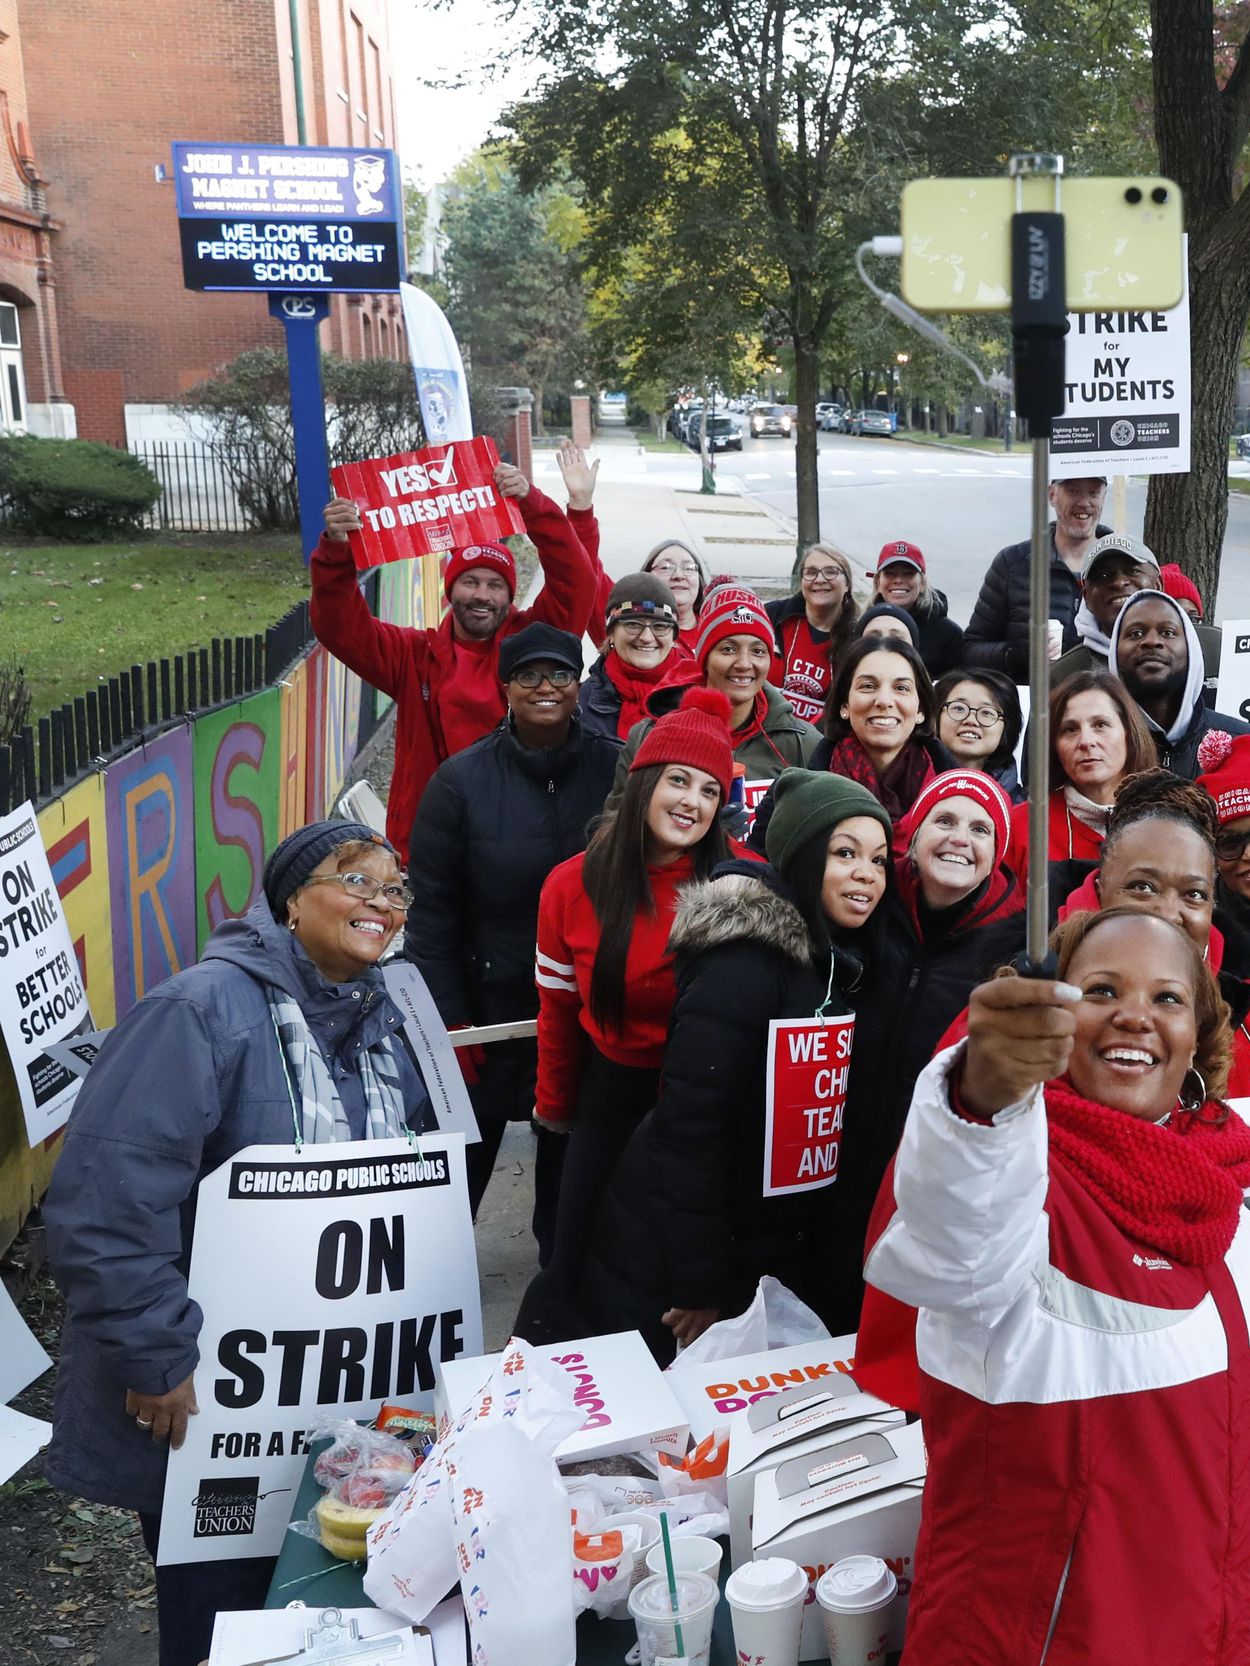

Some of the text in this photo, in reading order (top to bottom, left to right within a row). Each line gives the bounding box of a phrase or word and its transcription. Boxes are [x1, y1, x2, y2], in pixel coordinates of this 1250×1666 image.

[182, 154, 232, 174] JOHN
[258, 155, 349, 178] PERSHING
[191, 178, 343, 201] MAGNET SCHOOL
[221, 224, 353, 243] WELCOME TO
[197, 241, 385, 262] PERSHING MAGNET
[253, 263, 333, 282] SCHOOL
[1064, 311, 1168, 334] TRIKE
[1103, 341, 1120, 351] for
[1093, 357, 1131, 378] MY
[1065, 379, 1175, 403] TUDENTS
[1137, 428, 1170, 436] TEACHERS
[379, 464, 430, 497] YES
[366, 485, 496, 532] TO RESPECT!
[1104, 538, 1132, 550] DIEGO
[793, 658, 825, 680] CTU
[0, 834, 17, 851] UBLIC
[2, 860, 36, 905] ON
[0, 887, 58, 958] STRIKE
[35, 946, 47, 959] for
[16, 950, 72, 1009] BETTER
[20, 975, 83, 1044] SCHOOLS
[788, 1031, 829, 1063] WE
[797, 1142, 838, 1177] AND
[238, 1159, 446, 1193] CHICAGO PUBLIC SCHOOLS
[315, 1214, 405, 1300] ON
[705, 1358, 855, 1399] DUNKI
[210, 1432, 262, 1459] FOR
[266, 1431, 284, 1456] A
[197, 1504, 255, 1518] TEACHERS
[197, 1516, 253, 1533] UNION
